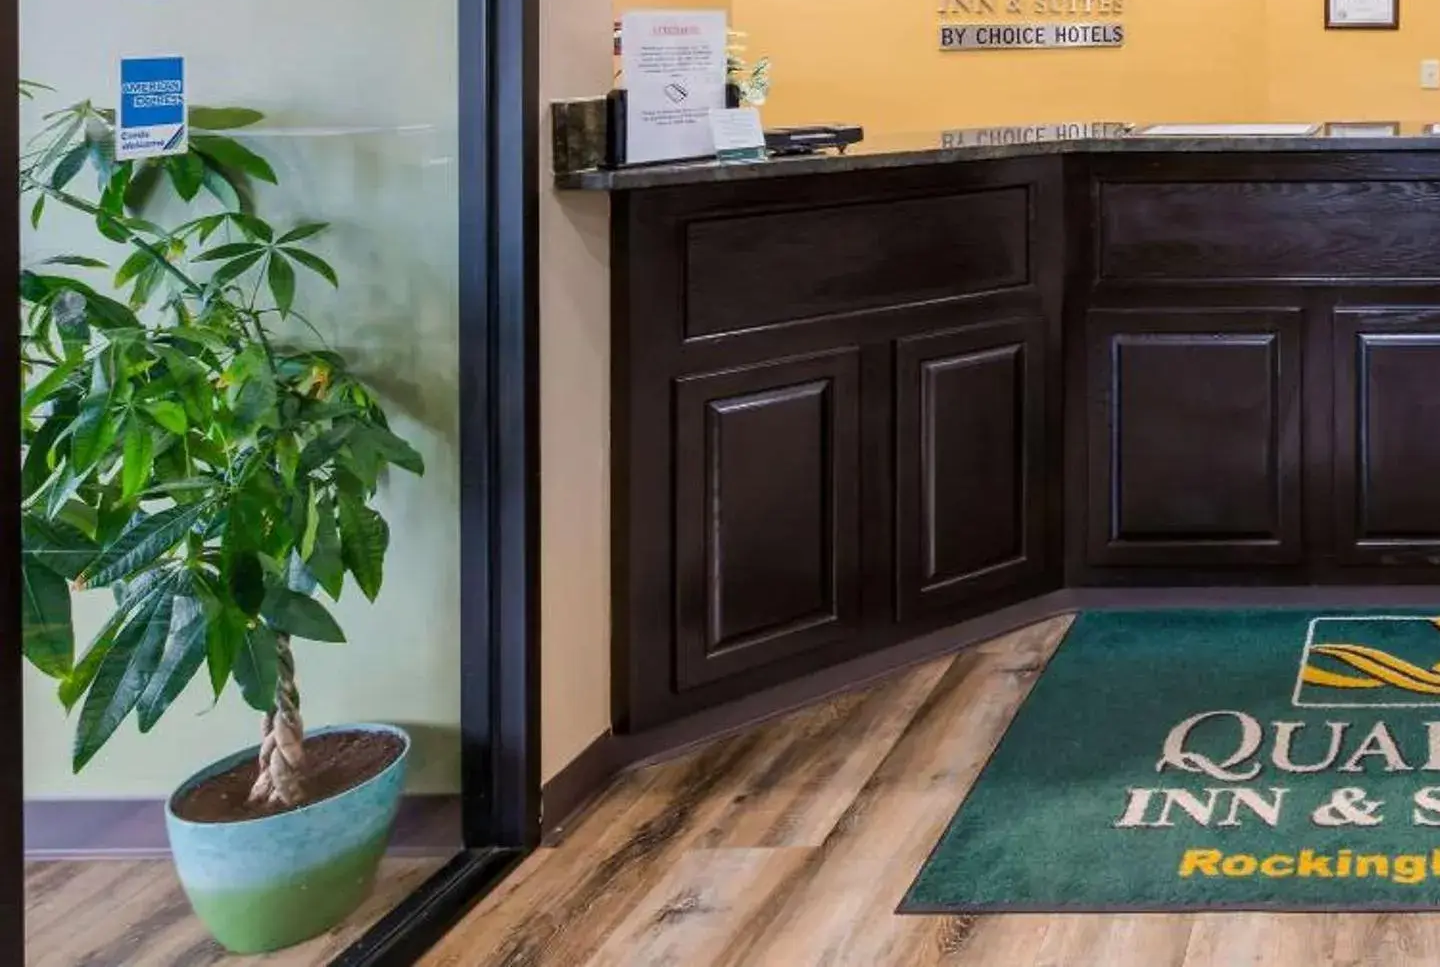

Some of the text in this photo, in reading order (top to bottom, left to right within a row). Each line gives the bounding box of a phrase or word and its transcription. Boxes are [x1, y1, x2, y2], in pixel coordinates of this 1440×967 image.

[941, 25, 1124, 46] BY CHOICE HOTELS
[1115, 786, 1290, 829] INN
[1312, 786, 1386, 826] &
